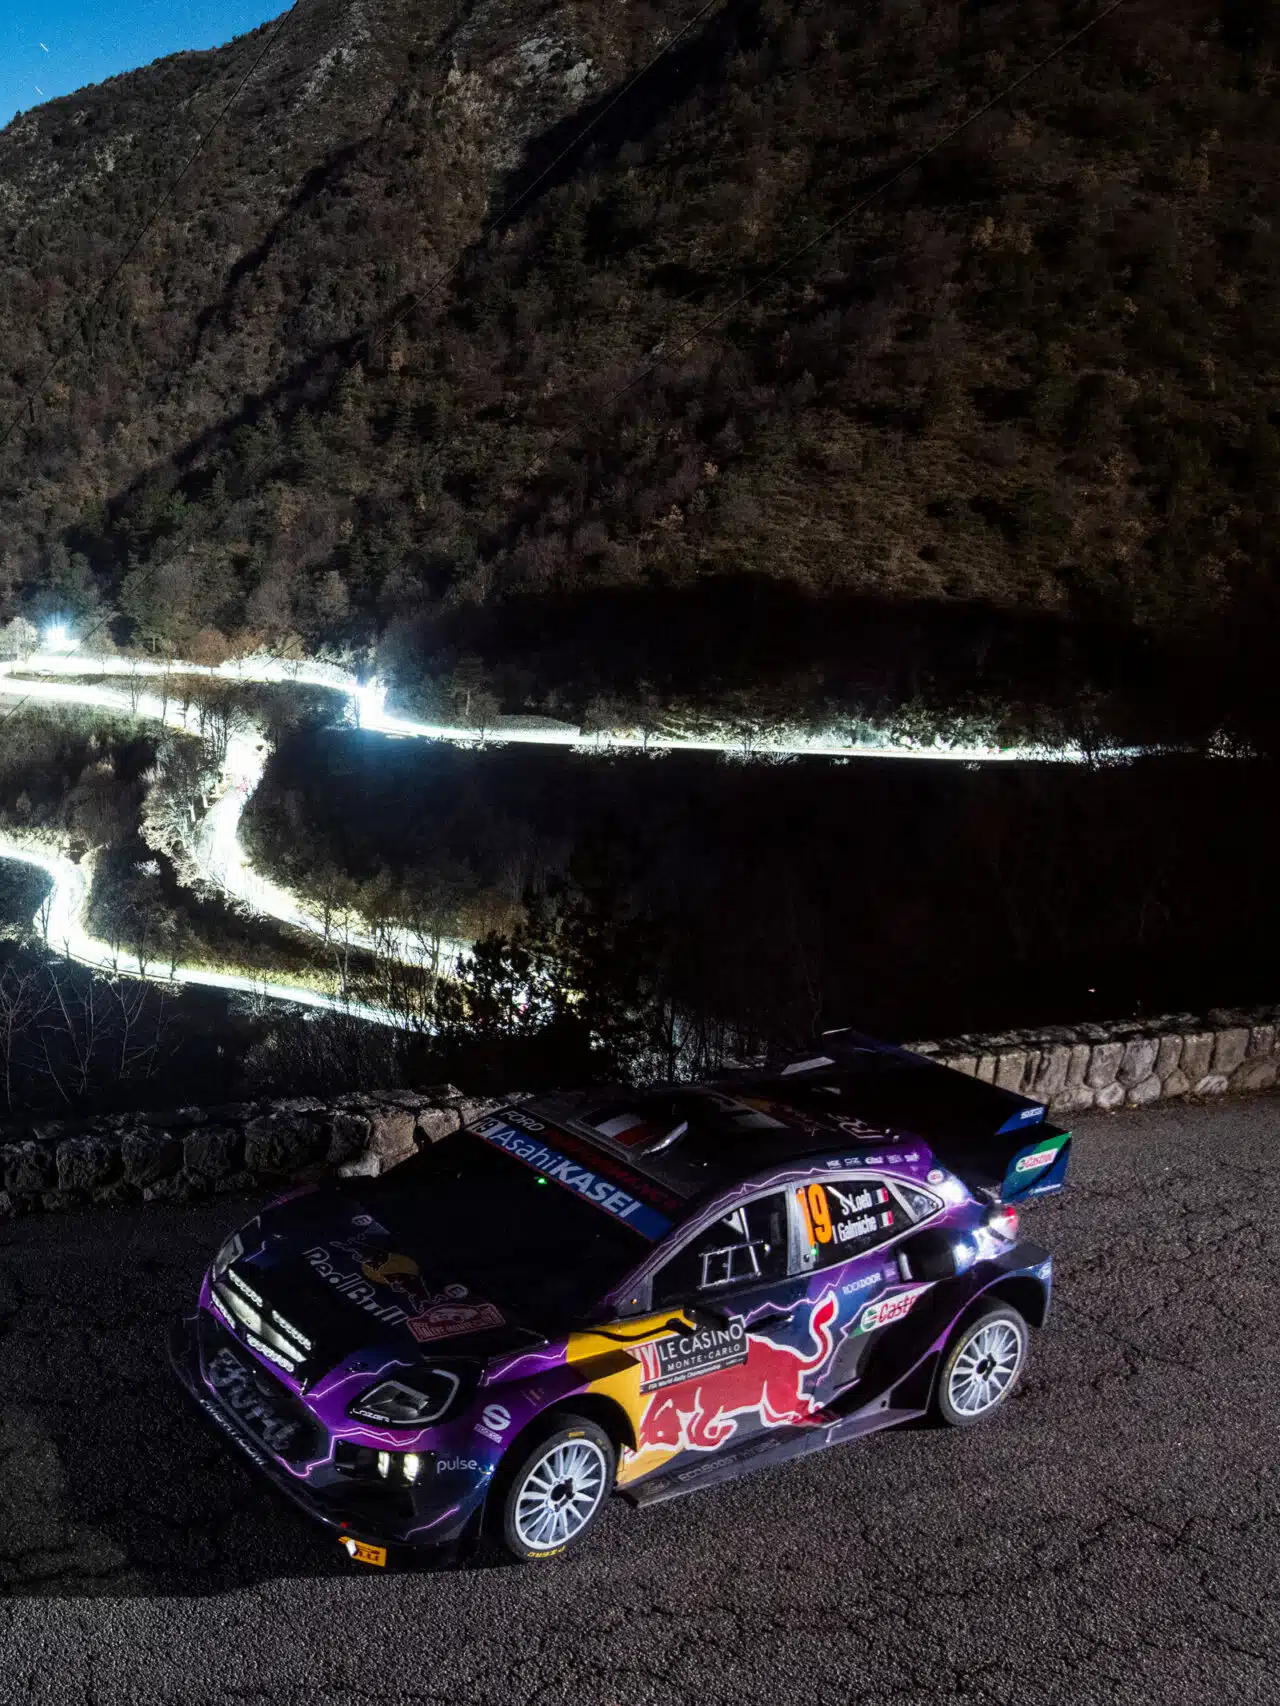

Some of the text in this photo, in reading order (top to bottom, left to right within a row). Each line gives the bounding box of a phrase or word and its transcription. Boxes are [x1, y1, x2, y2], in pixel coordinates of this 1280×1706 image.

[500, 1110, 547, 1133] FORD
[492, 1129, 644, 1218] AsahiKASEI
[795, 1183, 833, 1247] 19
[848, 1188, 873, 1213] Loeb
[837, 1214, 877, 1243] Galmiche
[658, 1323, 744, 1362] LE CASINO
[436, 1456, 478, 1474] pulse
